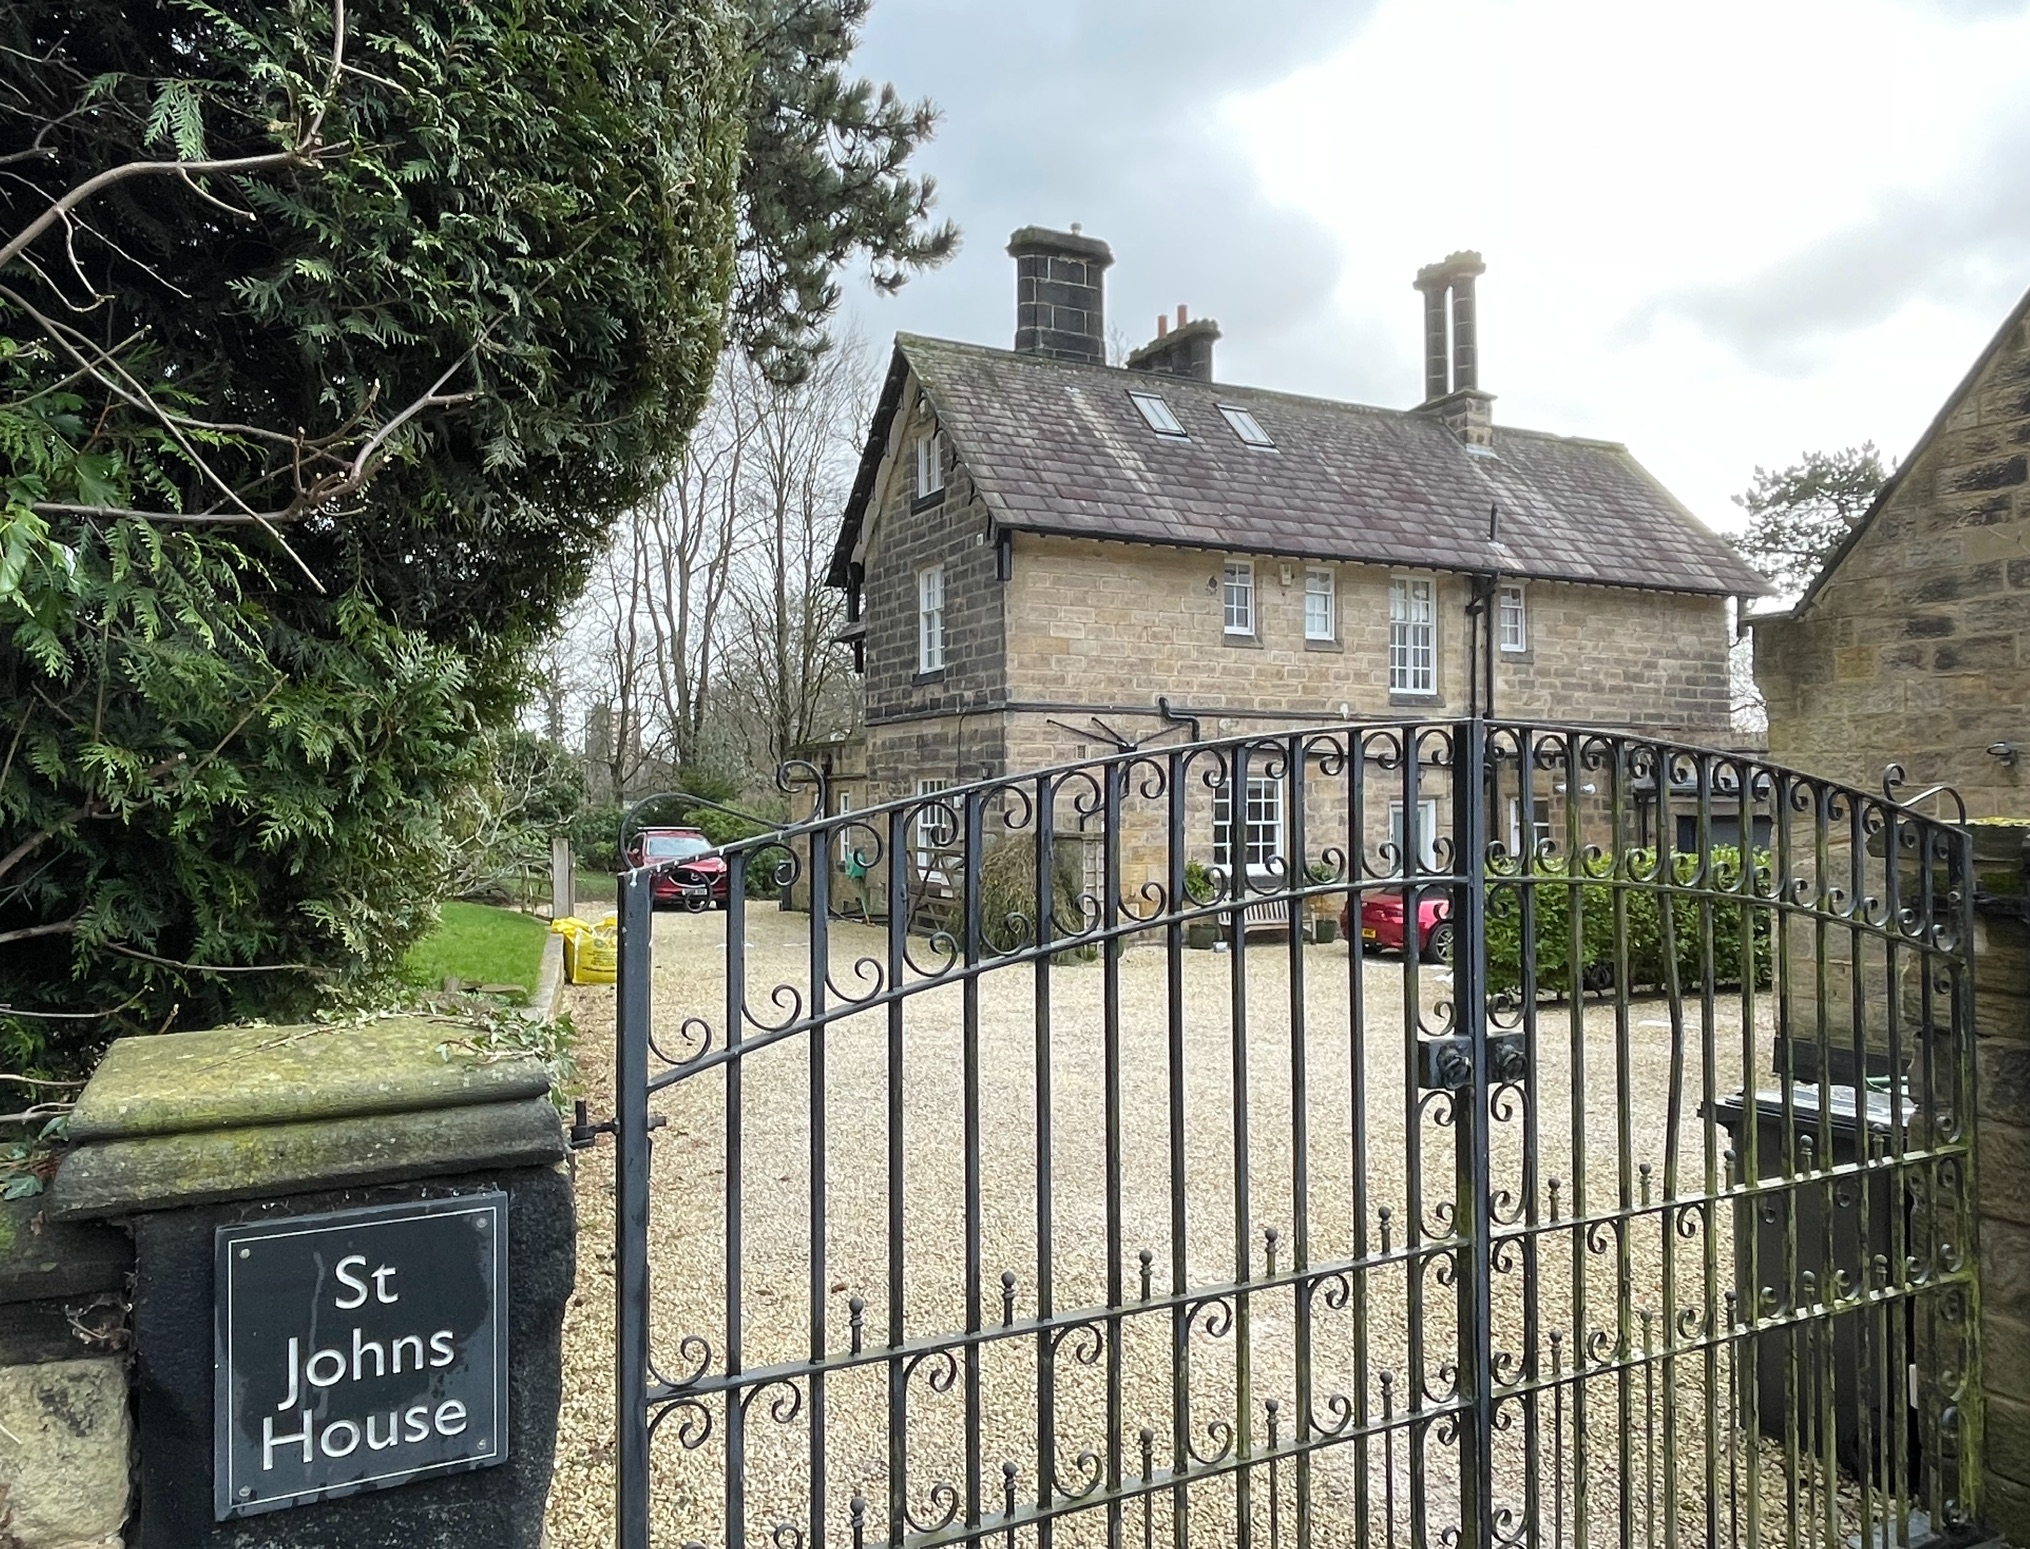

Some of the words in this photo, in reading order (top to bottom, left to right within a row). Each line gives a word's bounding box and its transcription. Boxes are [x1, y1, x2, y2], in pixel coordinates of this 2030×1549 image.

[335, 1254, 399, 1309] St
[277, 1328, 456, 1411] Johns
[262, 1399, 467, 1470] House
